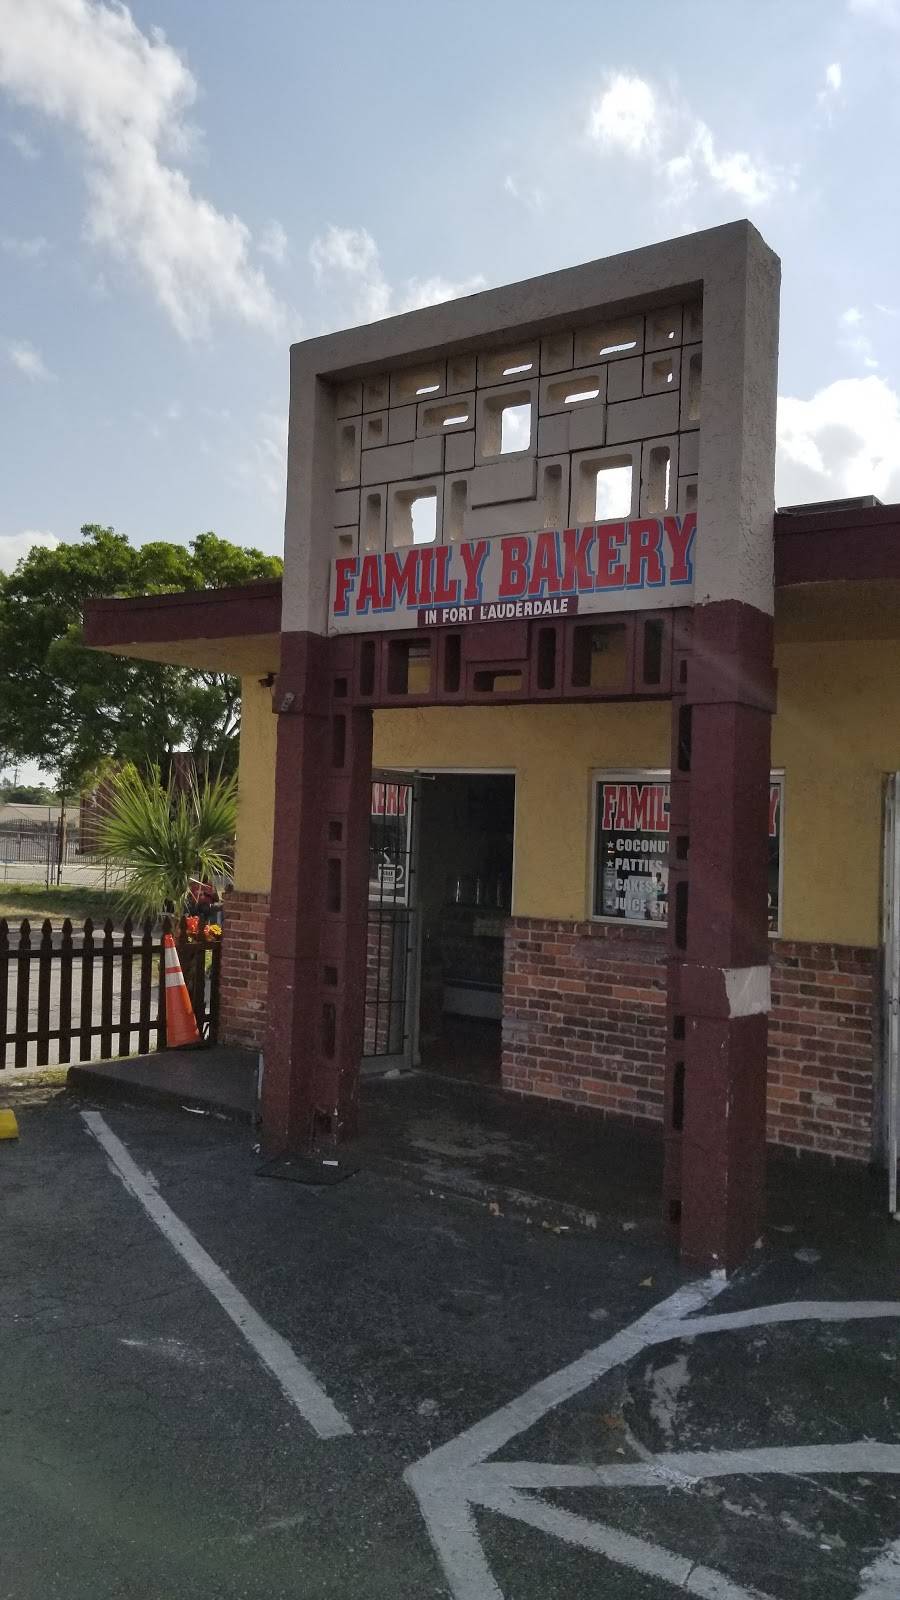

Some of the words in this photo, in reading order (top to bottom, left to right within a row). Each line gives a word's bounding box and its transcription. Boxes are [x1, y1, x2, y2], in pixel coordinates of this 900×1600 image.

[333, 539, 491, 617] FAMILY
[498, 512, 698, 601] BAKERY
[424, 608, 437, 624] IN
[442, 605, 474, 623] FORT
[480, 598, 569, 620] LAUDERDALE
[602, 784, 671, 832] FAMIL
[615, 857, 663, 872] PATTIES
[614, 896, 647, 912] JUICE
